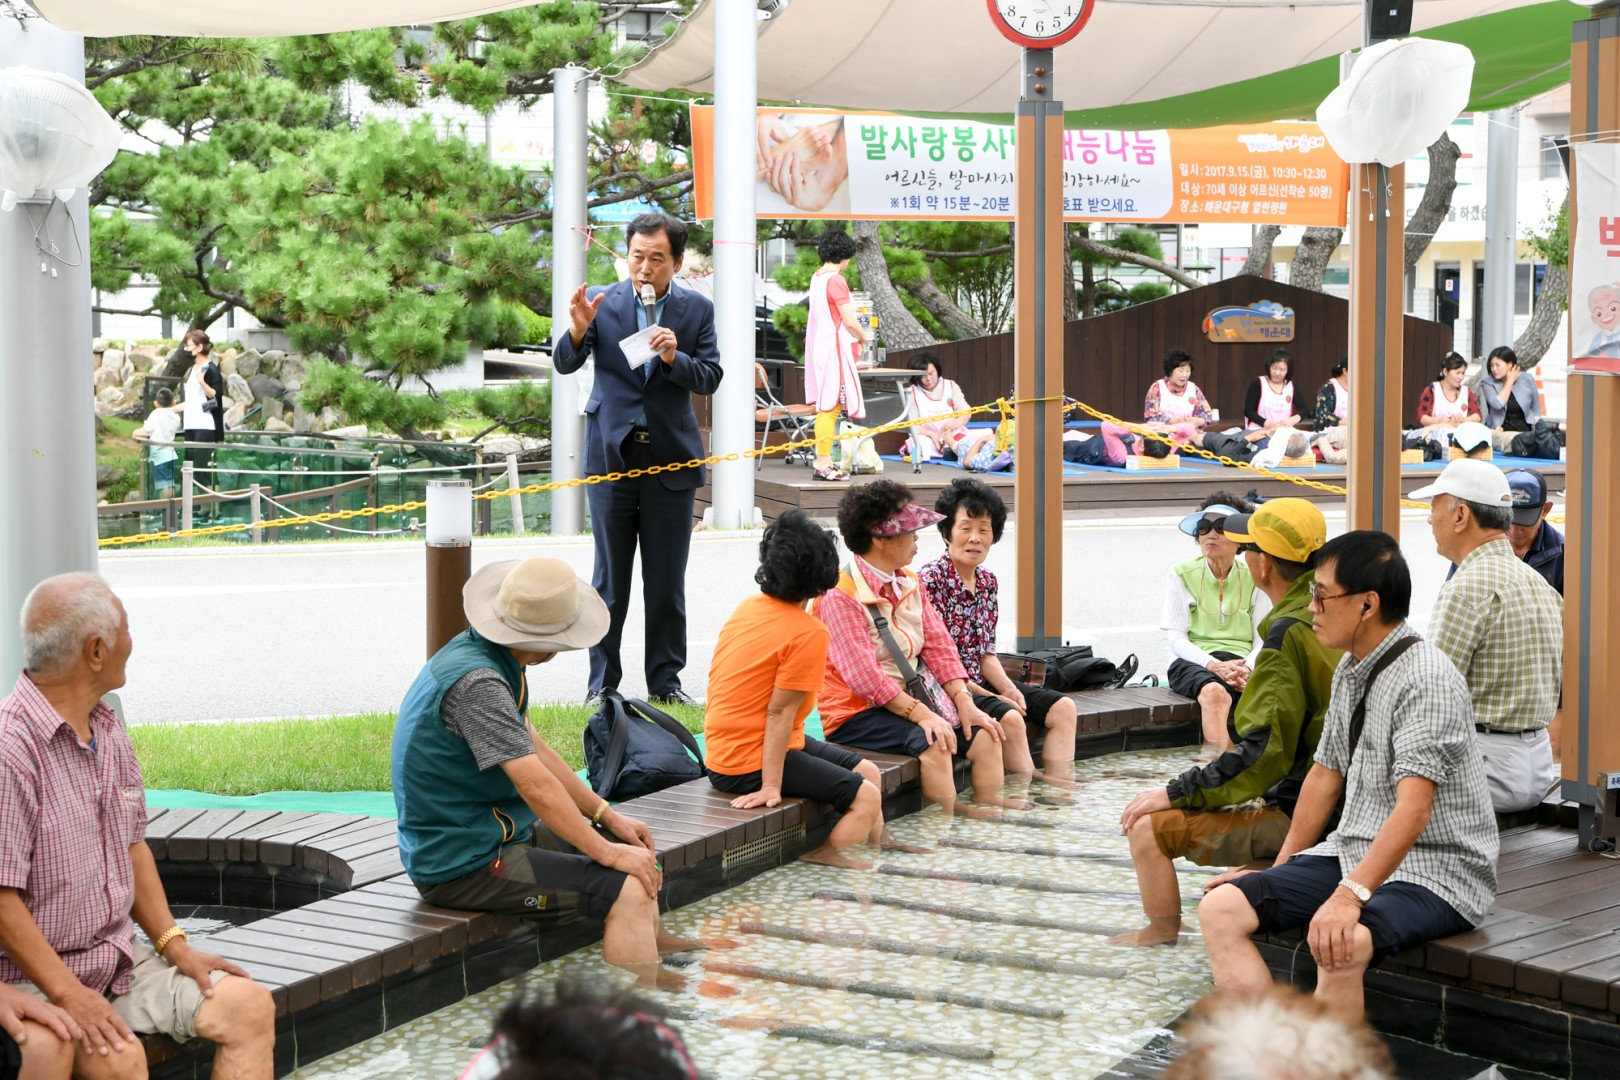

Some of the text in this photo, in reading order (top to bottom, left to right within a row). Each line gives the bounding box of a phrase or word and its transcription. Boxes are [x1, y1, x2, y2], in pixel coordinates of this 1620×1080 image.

[1007, 5, 1016, 17] 8
[1063, 5, 1072, 17] 4
[1019, 16, 1028, 28] 7
[1035, 20, 1044, 33] 6
[1052, 16, 1061, 28] 5
[860, 124, 1015, 163] 발사랑봉사
[885, 168, 942, 191] 어르신들,
[949, 169, 1014, 191] 발마사지
[1272, 167, 1327, 180] 10:30~12:30
[1205, 183, 1226, 196] 70세
[1229, 183, 1247, 197] 이상
[1308, 186, 1333, 199] 50명)
[926, 195, 939, 211] 약
[943, 196, 1010, 211] 15분~20분
[1063, 197, 1083, 211] 호표
[1088, 197, 1138, 213] 받으세요.
[1204, 200, 1250, 214] 해운대구청
[1460, 204, 1487, 221] 하겠습
